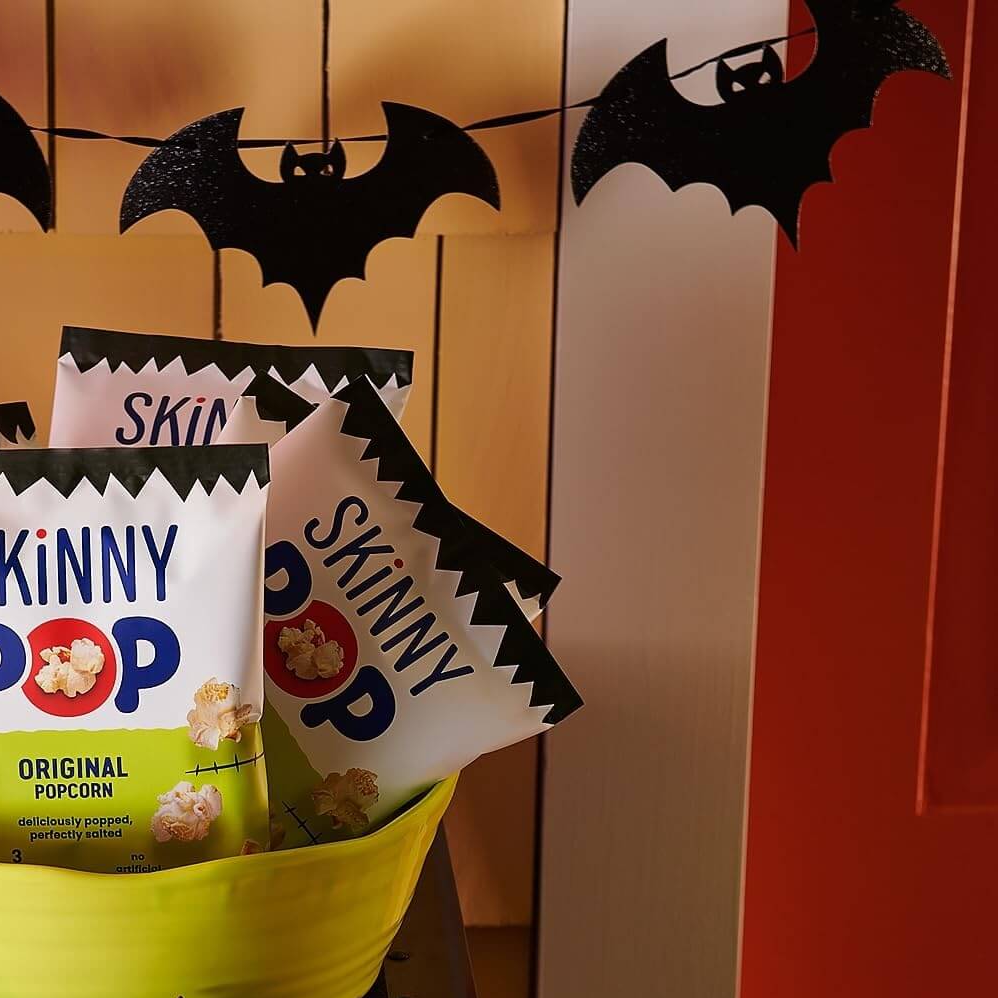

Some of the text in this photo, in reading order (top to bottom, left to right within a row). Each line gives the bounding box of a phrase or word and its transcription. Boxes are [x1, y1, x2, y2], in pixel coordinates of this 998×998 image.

[265, 540, 396, 742] POP
[18, 757, 128, 780] ORIGINAL
[35, 783, 113, 799] POPCORN
[18, 815, 133, 828] deliciously popped,
[30, 828, 122, 842] perfectly salted
[11, 849, 23, 863] 3
[130, 853, 145, 861] no
[115, 863, 162, 873] artificial
